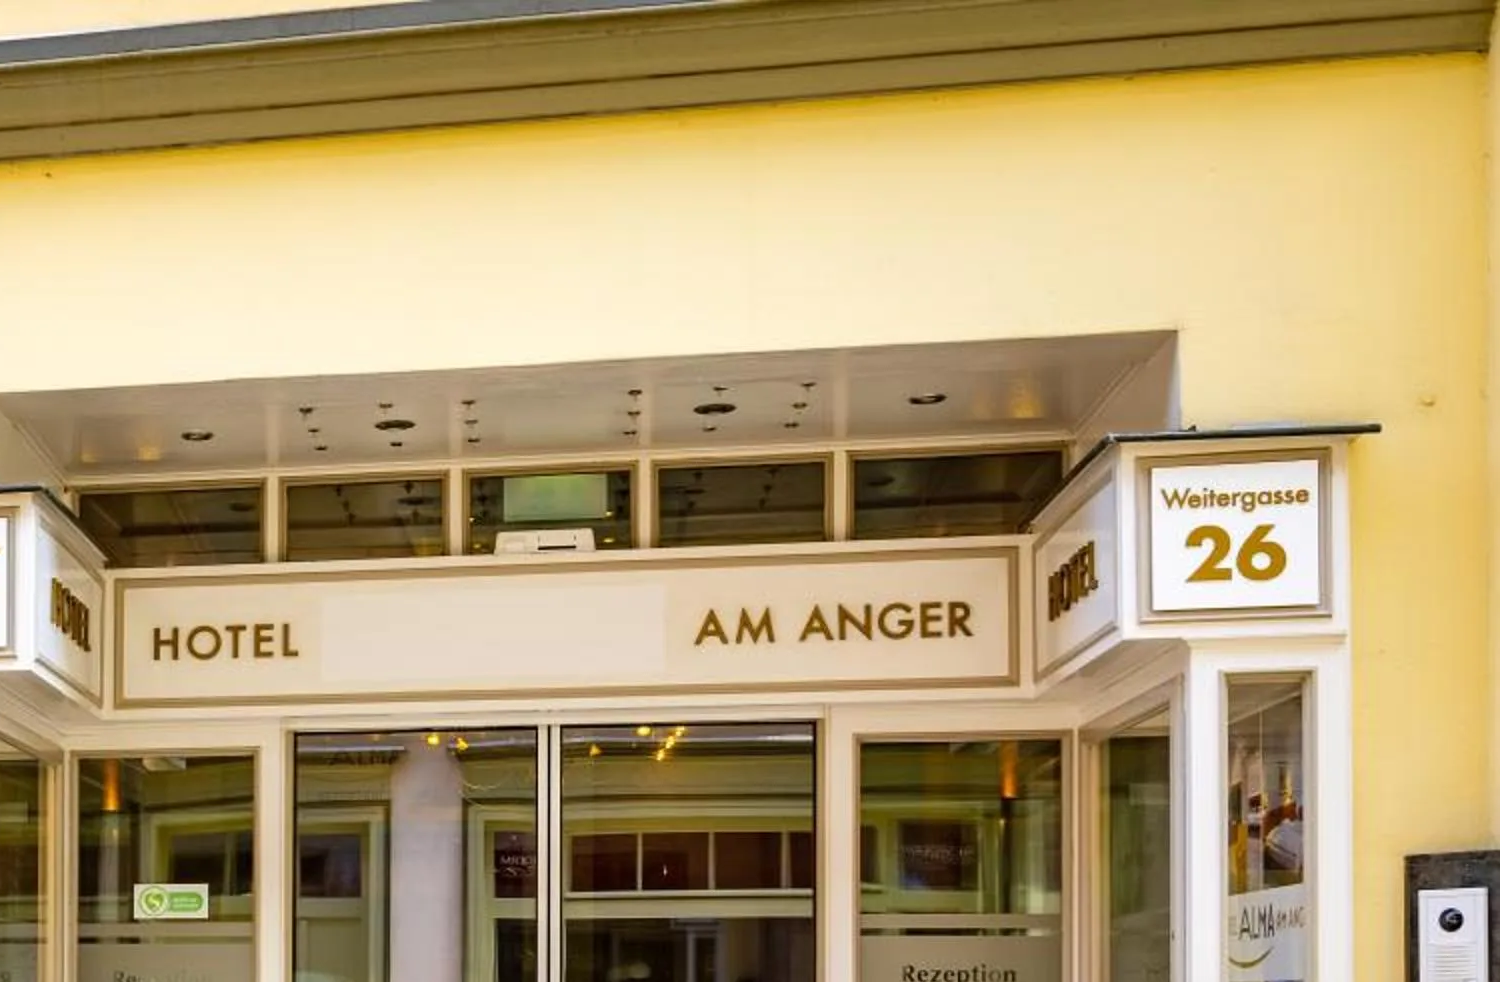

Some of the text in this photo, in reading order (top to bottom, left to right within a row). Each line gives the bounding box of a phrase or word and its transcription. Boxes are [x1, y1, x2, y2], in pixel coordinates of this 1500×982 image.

[1160, 486, 1310, 513] Weitergasse
[1048, 540, 1099, 622] HOTEL
[1184, 523, 1288, 584] 26
[50, 576, 92, 652] HOTEL
[152, 601, 974, 661] HOTEL AM ANGER
[1238, 902, 1276, 941] ALMA
